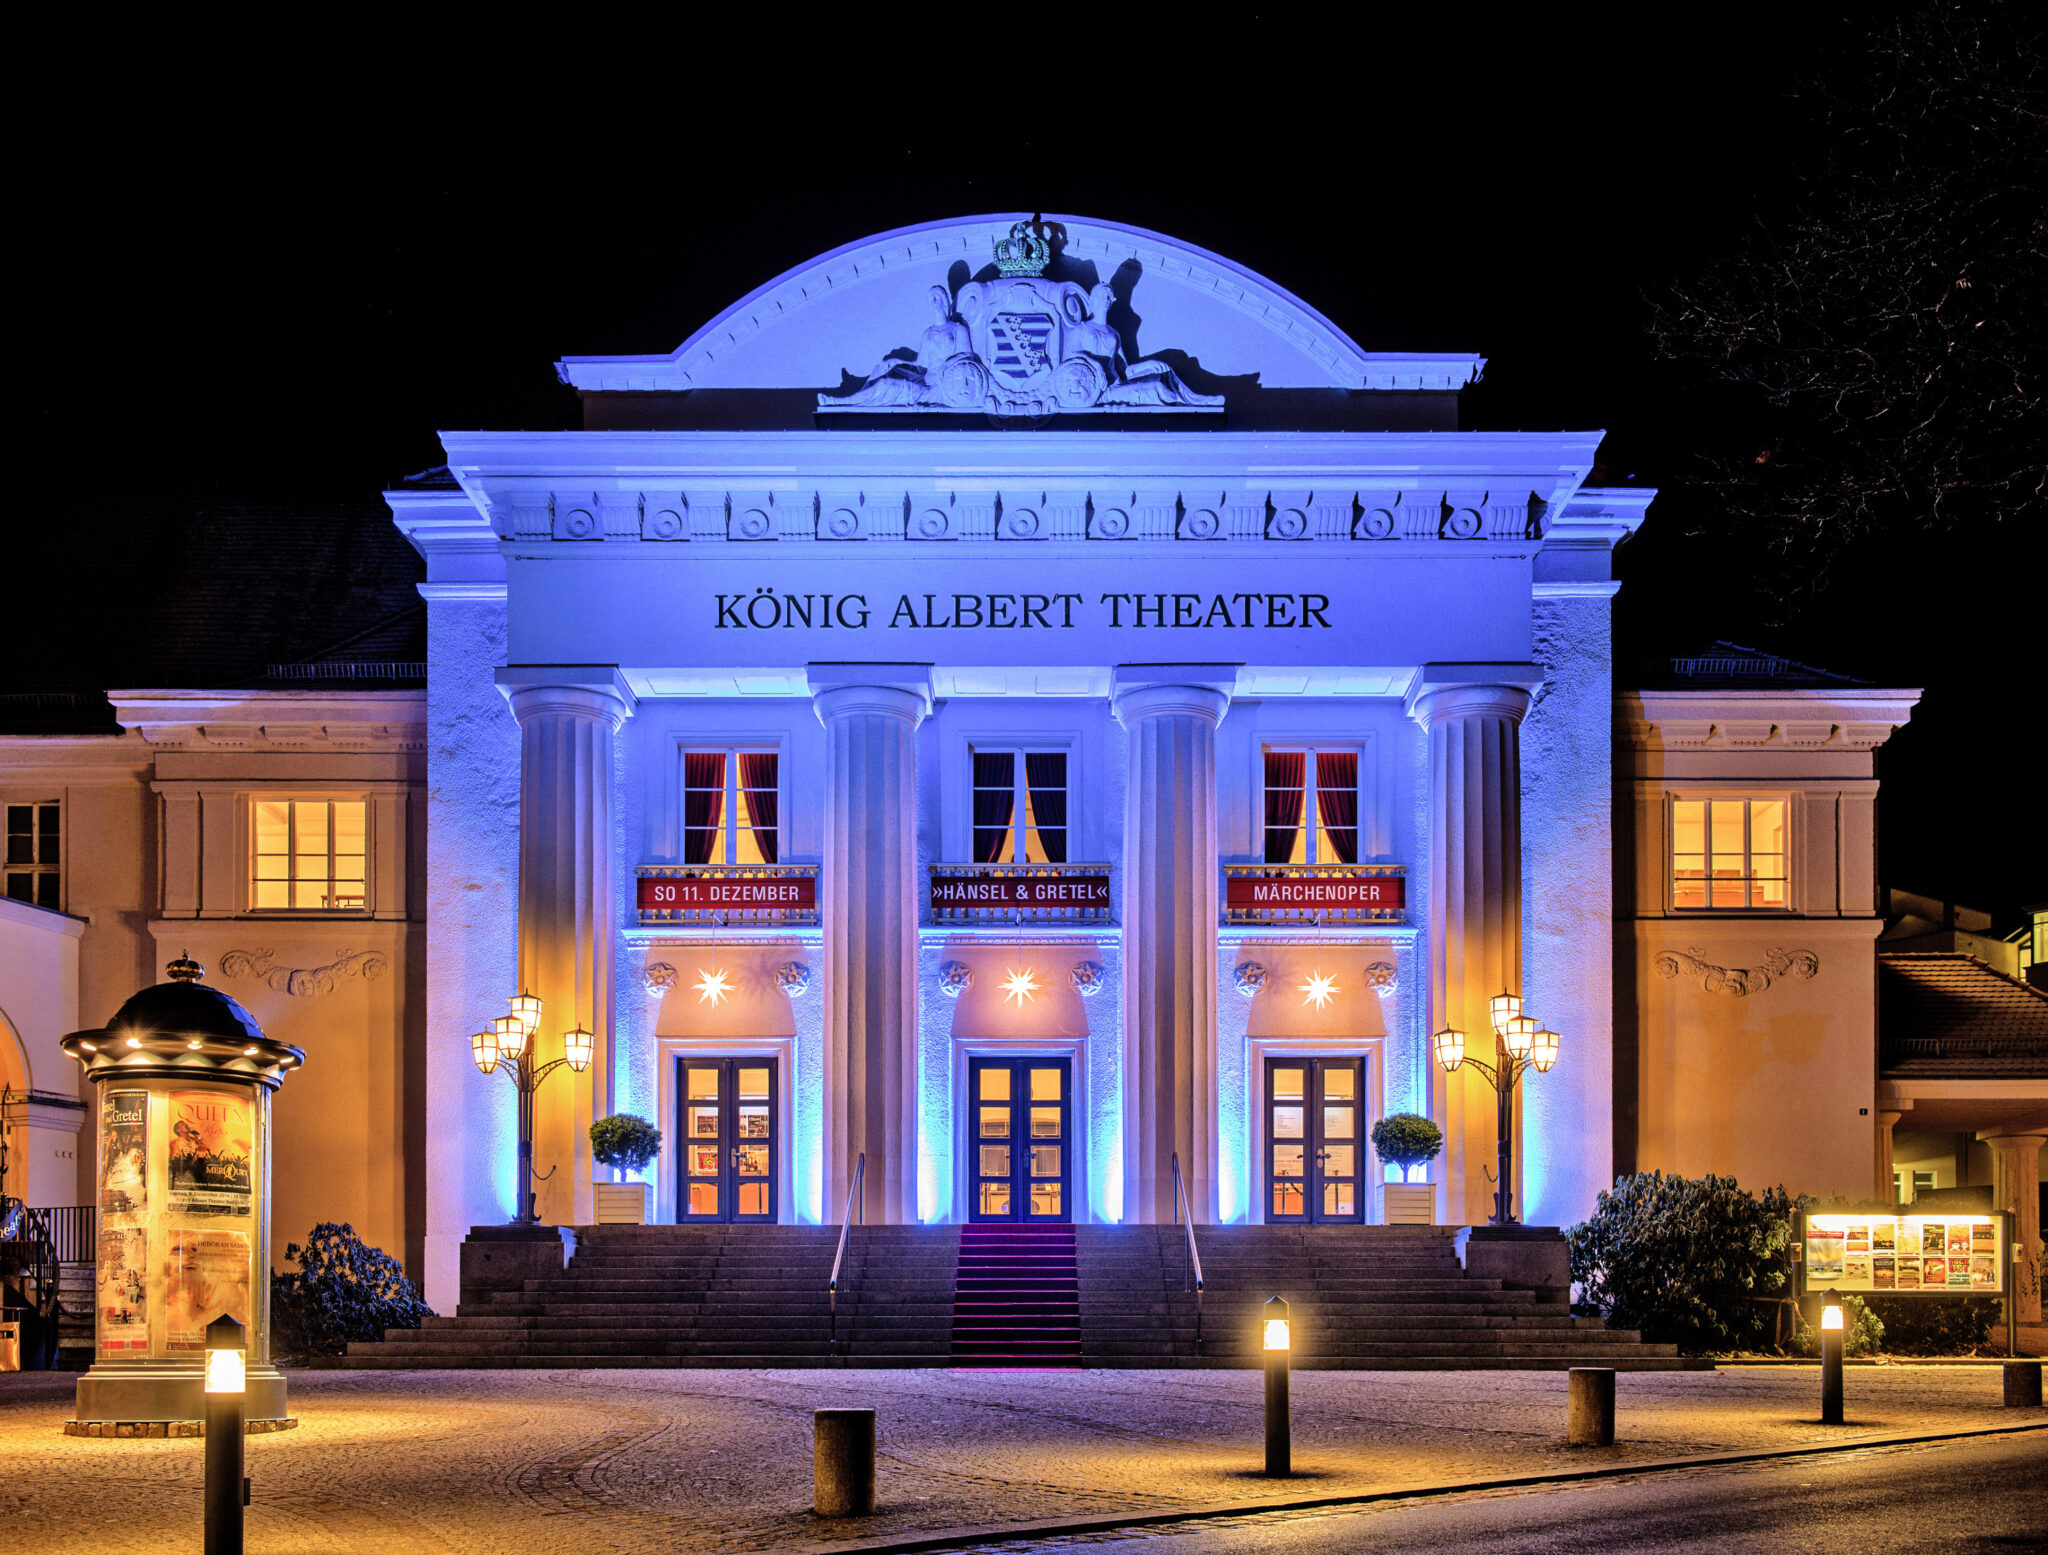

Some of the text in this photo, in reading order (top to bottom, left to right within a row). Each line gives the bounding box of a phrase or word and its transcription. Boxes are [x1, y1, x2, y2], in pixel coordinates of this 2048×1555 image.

[714, 587, 1332, 629] KÖNIG ALBERT THEATER
[654, 886, 799, 901] SO 11. DEZEMBER
[1015, 884, 1029, 900] &
[1253, 883, 1380, 901] MÄRCHENOPER
[112, 1109, 143, 1122] Gretel
